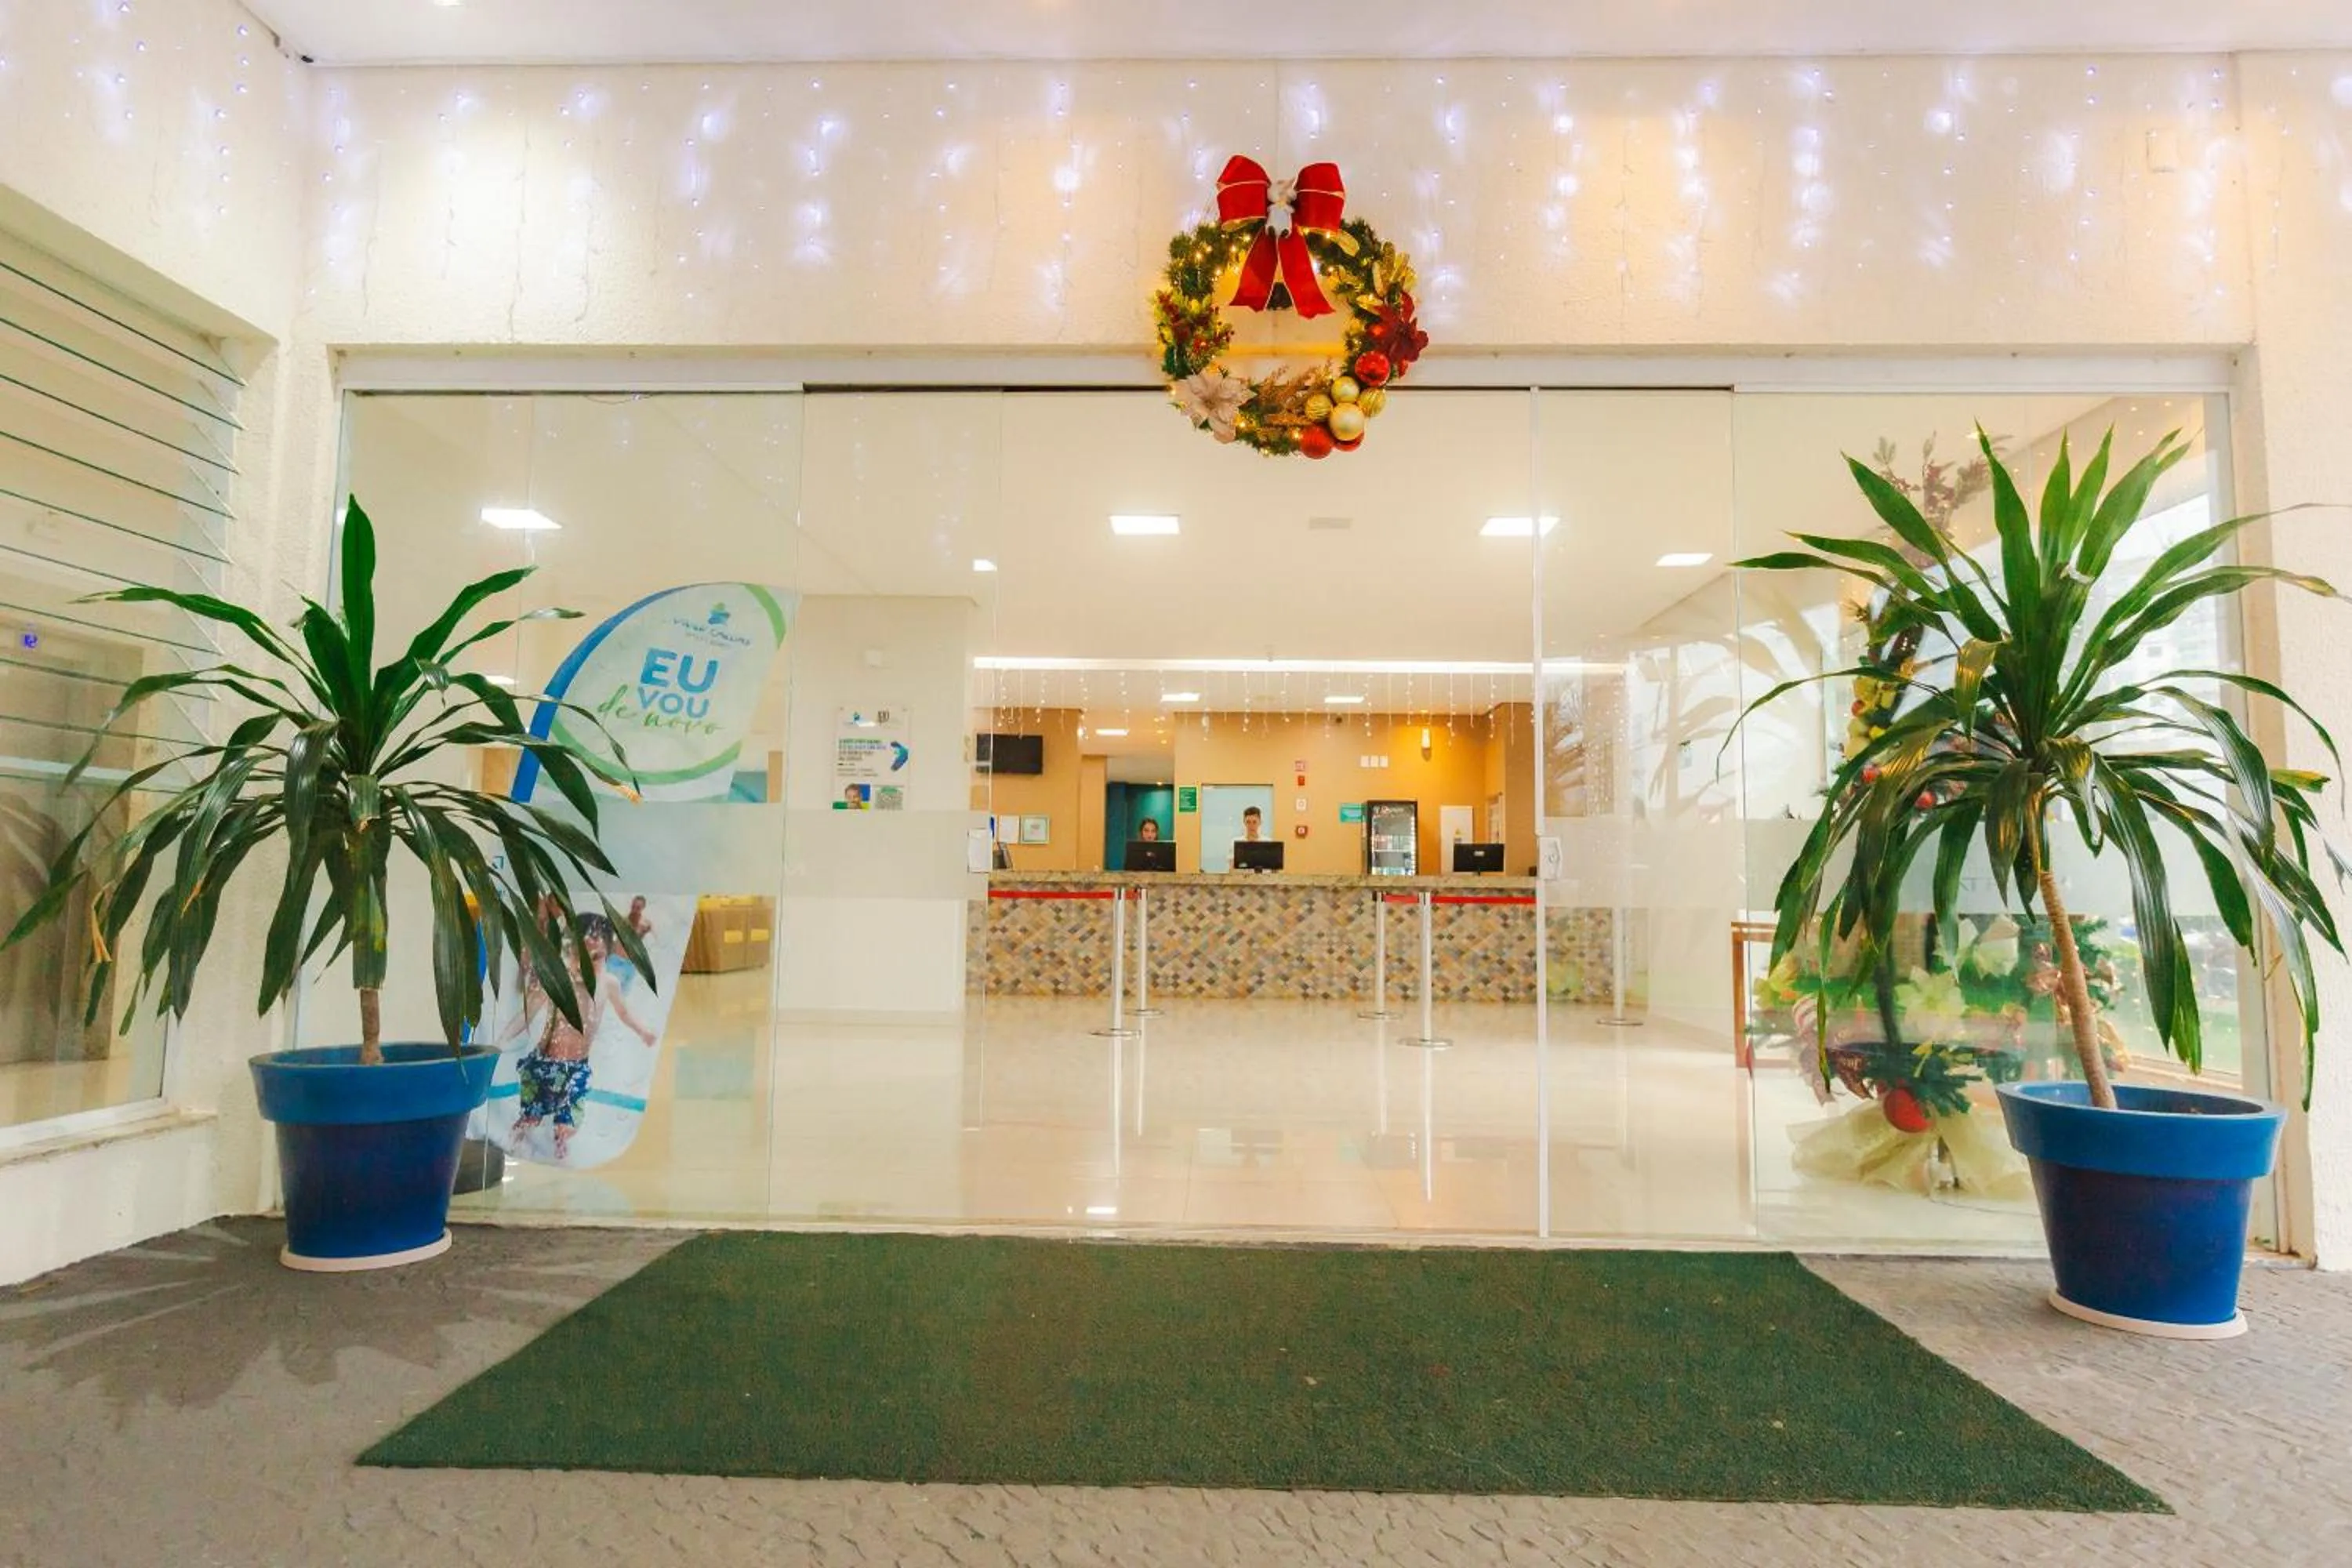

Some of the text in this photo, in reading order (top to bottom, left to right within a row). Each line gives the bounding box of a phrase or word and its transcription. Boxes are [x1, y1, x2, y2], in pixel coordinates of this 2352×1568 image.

[640, 648, 719, 693] EU
[597, 684, 637, 718] de
[637, 686, 710, 719] VOU
